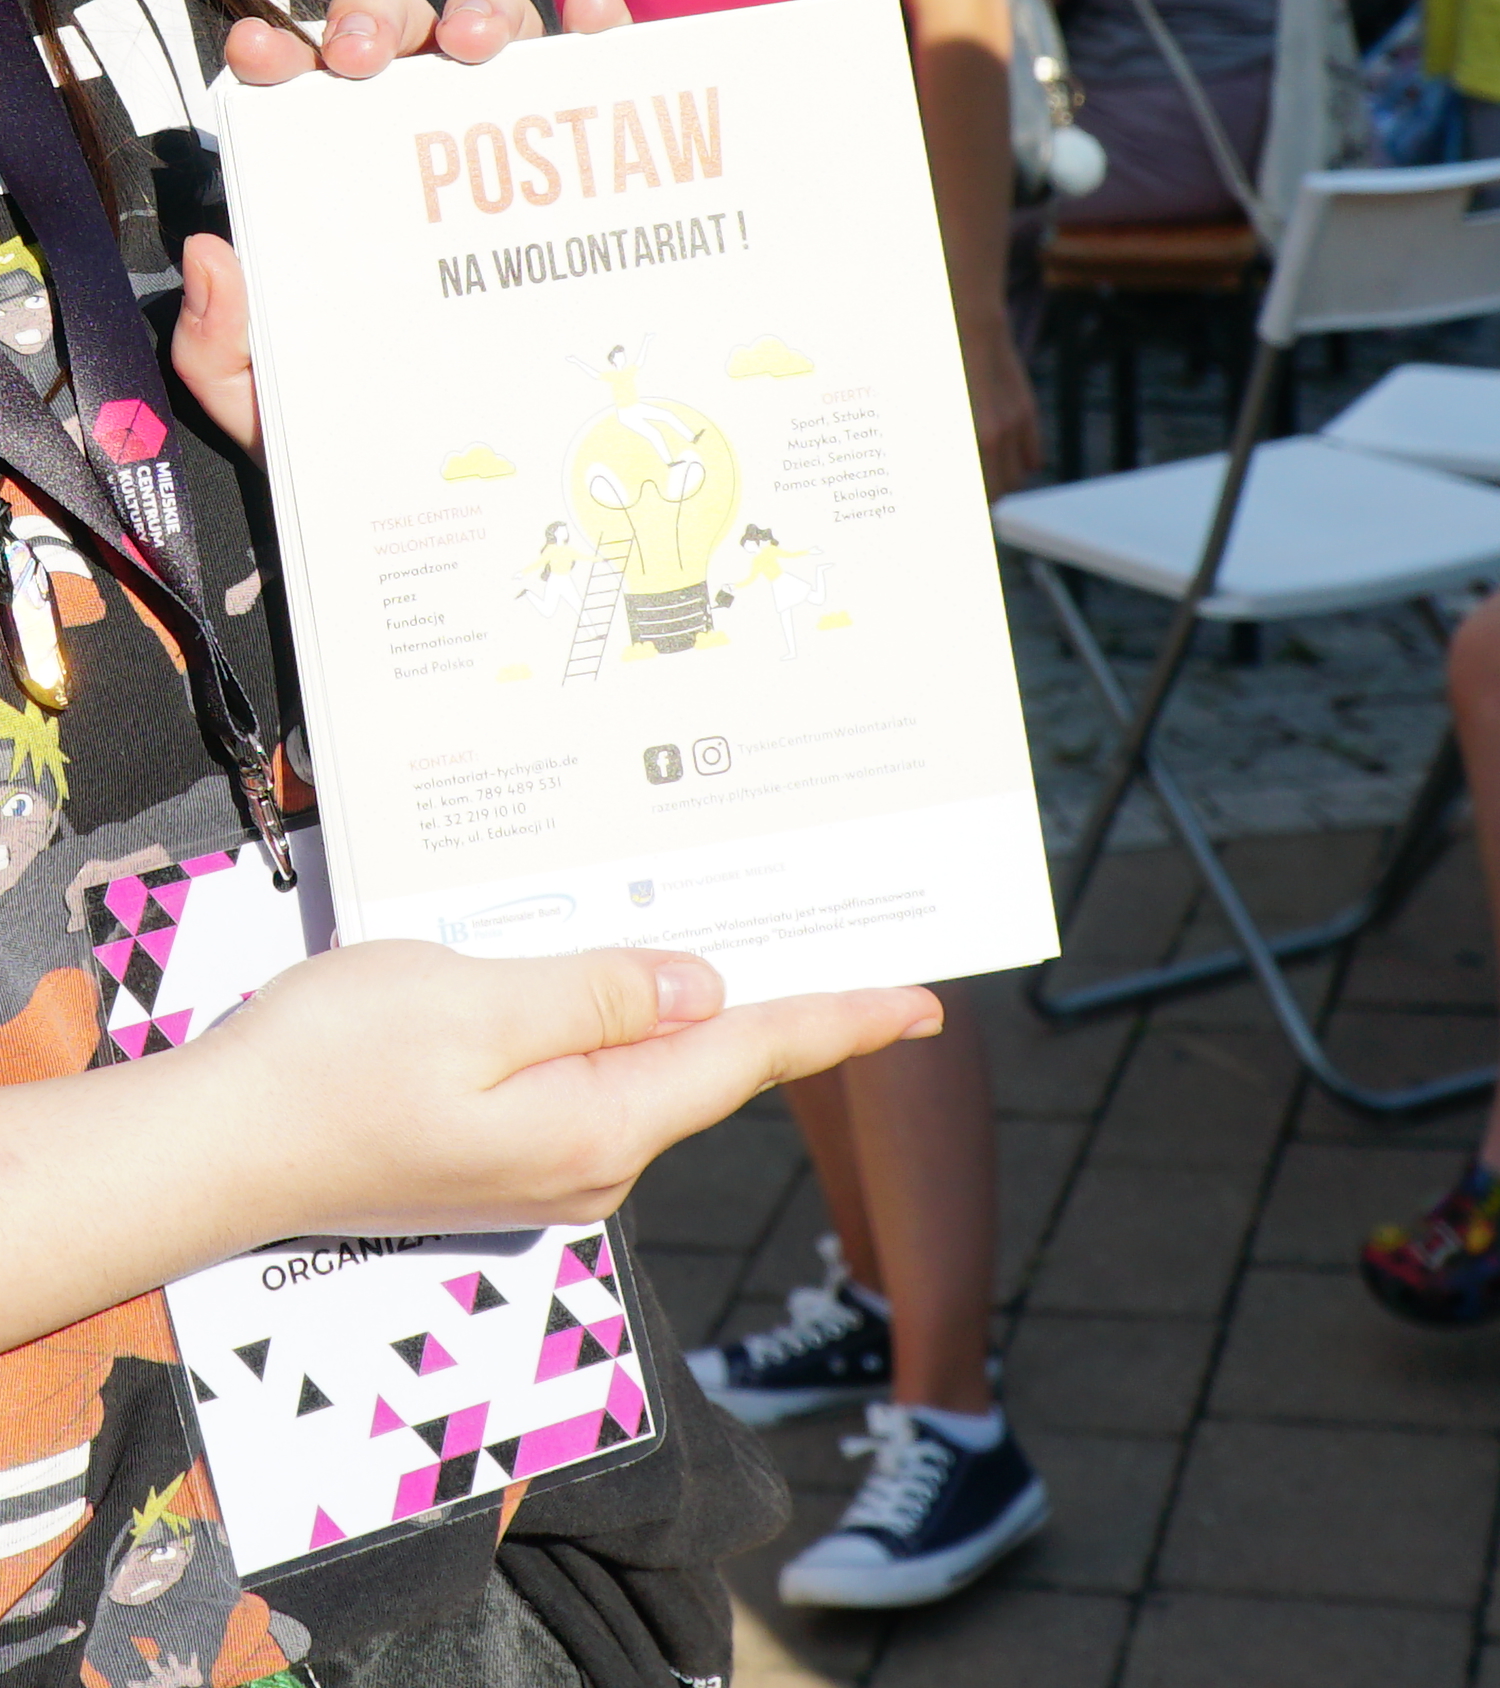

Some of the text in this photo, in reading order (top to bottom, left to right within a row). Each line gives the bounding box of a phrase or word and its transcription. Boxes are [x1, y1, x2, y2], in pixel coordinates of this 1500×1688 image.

[413, 85, 723, 224] POSTAW
[437, 252, 487, 298] NA
[492, 212, 727, 290] WOLONTARIAT
[791, 408, 880, 432] Sport, Sztuka,
[787, 427, 883, 450] Muzyka, Teatr,
[782, 448, 886, 471] Dzieci, Seniorzy,
[774, 467, 889, 492] Pomoc społeczna,
[118, 468, 150, 543] KULTURY
[137, 465, 165, 548] CENTRUM
[156, 462, 181, 534] MIEJSKIE
[833, 486, 893, 503] Ekologia,
[371, 505, 483, 533] TYSKIE CENTRUM
[834, 504, 896, 522] Zwierzęta
[374, 528, 487, 555] WOLONTARIATU
[378, 560, 459, 585] prowadzone
[383, 592, 417, 609] przez
[390, 629, 489, 655] Internationaler
[394, 658, 475, 679] Bund Polska
[737, 715, 918, 755] TyskieCentrumWolontariatu
[408, 749, 479, 771] KONTAKT:
[412, 754, 579, 791] wolontariat-tychy@ib.de
[416, 775, 562, 812] tel. kom. 789 489 531
[651, 758, 926, 814] razemtychy.pl/tyskie-centrum-wolontariatu
[419, 801, 526, 831] tel. 32 219 10 10
[421, 835, 465, 852] Tychy,
[468, 830, 484, 844] ul.
[487, 821, 542, 840] Edukacji
[705, 870, 741, 885] DOBRE
[472, 910, 535, 928] Internationaler
[538, 906, 561, 918] Bund
[623, 933, 660, 948] Tyskie
[662, 924, 713, 942] Centrum
[714, 911, 793, 932] Wolontariatu
[794, 905, 816, 921] jest
[818, 888, 926, 914] współfinansowane
[699, 932, 770, 957] publicznego
[847, 903, 937, 929] wspomagająca
